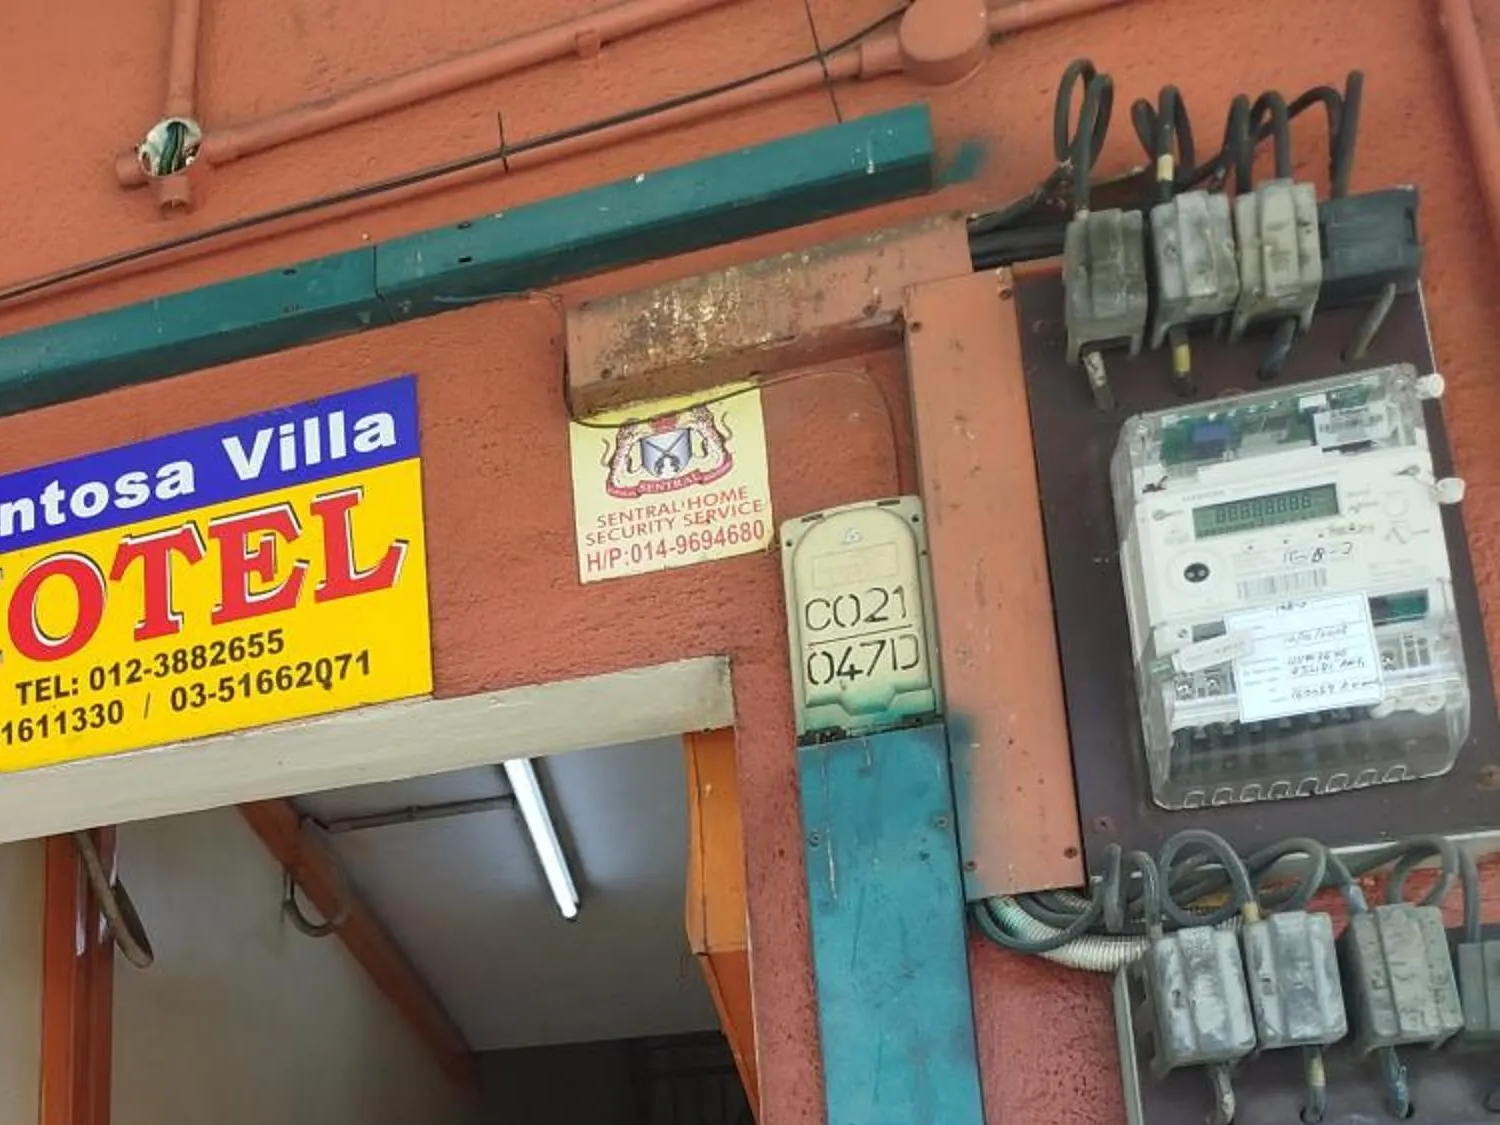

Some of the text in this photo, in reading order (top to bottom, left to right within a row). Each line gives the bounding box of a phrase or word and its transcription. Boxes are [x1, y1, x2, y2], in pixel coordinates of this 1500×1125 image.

[221, 410, 396, 481] Villa
[585, 499, 763, 546] SECURITY SERVICE
[597, 486, 748, 528] SENTRAL HOME
[15, 629, 284, 706] TEL: 012-3882655
[171, 650, 371, 713] 03-51662071
